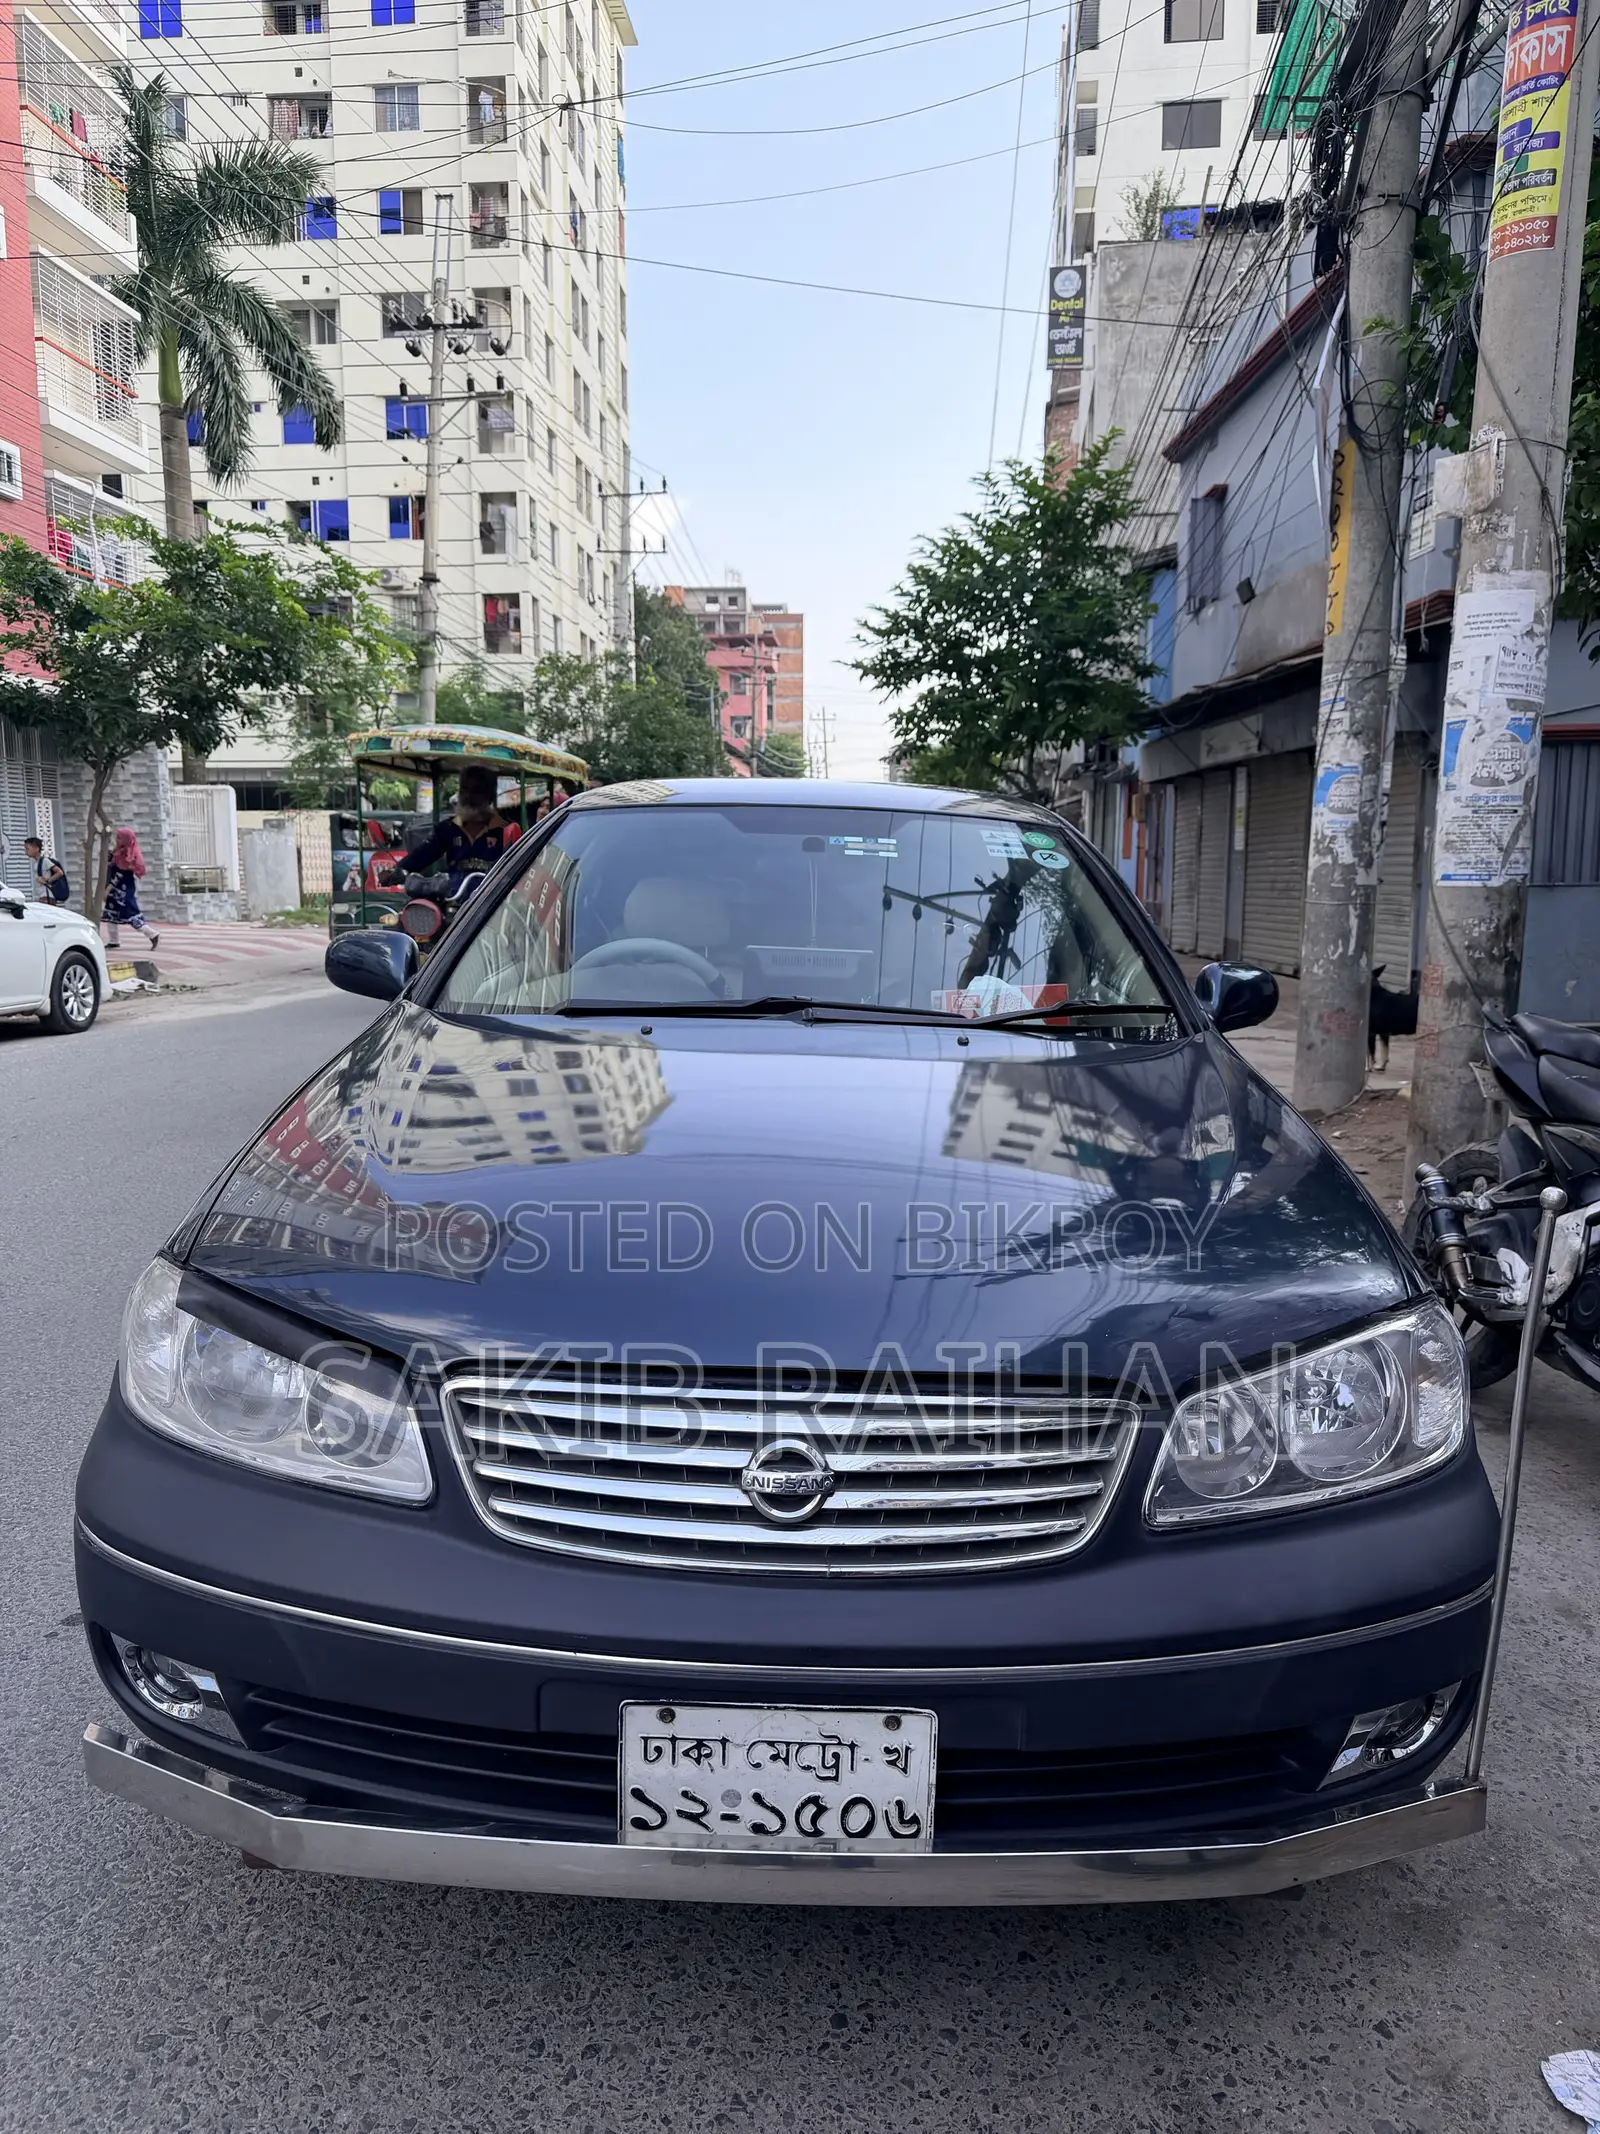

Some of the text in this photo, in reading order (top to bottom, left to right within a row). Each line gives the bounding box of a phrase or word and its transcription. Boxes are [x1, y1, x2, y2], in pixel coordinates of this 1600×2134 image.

[1050, 298, 1084, 311] Dental
[752, 1475, 824, 1491] NISSAN
[639, 1733, 731, 1770] ঢাকা
[629, 1785, 922, 1839] ১২-১৫০৬
